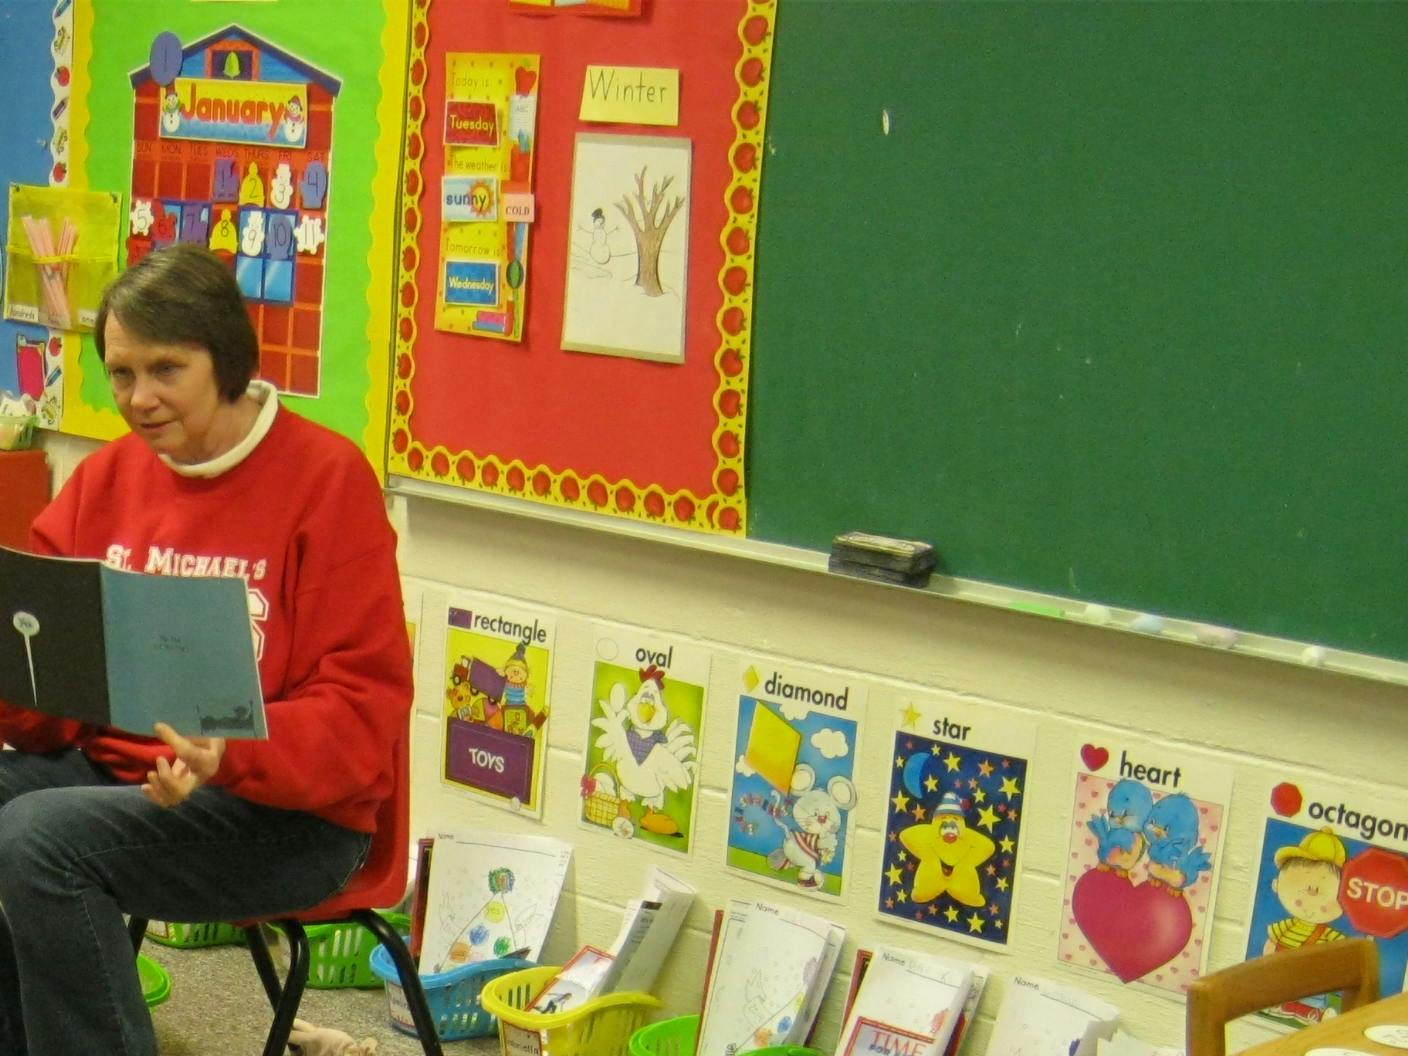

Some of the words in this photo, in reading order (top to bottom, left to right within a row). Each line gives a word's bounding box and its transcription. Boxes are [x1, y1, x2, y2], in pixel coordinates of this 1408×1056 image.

[449, 72, 479, 91] Today
[588, 68, 668, 104] Winter
[180, 82, 286, 142] January
[449, 114, 494, 137] Tuesday
[465, 159, 497, 170] weather
[248, 178, 259, 198] 2
[274, 184, 285, 204] 3
[307, 172, 319, 194] 4
[446, 192, 487, 212] sunny
[505, 205, 530, 217] COLD
[137, 208, 148, 228] 5
[220, 219, 230, 238] 8
[247, 229, 257, 250] 9
[273, 223, 287, 247] 10
[445, 238, 490, 256] Tomorrow
[449, 276, 495, 295] Wednesday
[473, 613, 548, 646] rectangle
[635, 646, 674, 668] oval
[764, 672, 849, 711] diamond
[932, 716, 971, 741] star
[468, 748, 505, 774] TOYS
[1119, 750, 1182, 788] heart
[1308, 802, 1408, 841] octagon
[755, 901, 780, 915] Name
[882, 952, 906, 967] Name
[1013, 976, 1040, 991] Name
[872, 1031, 928, 1056] TIME
